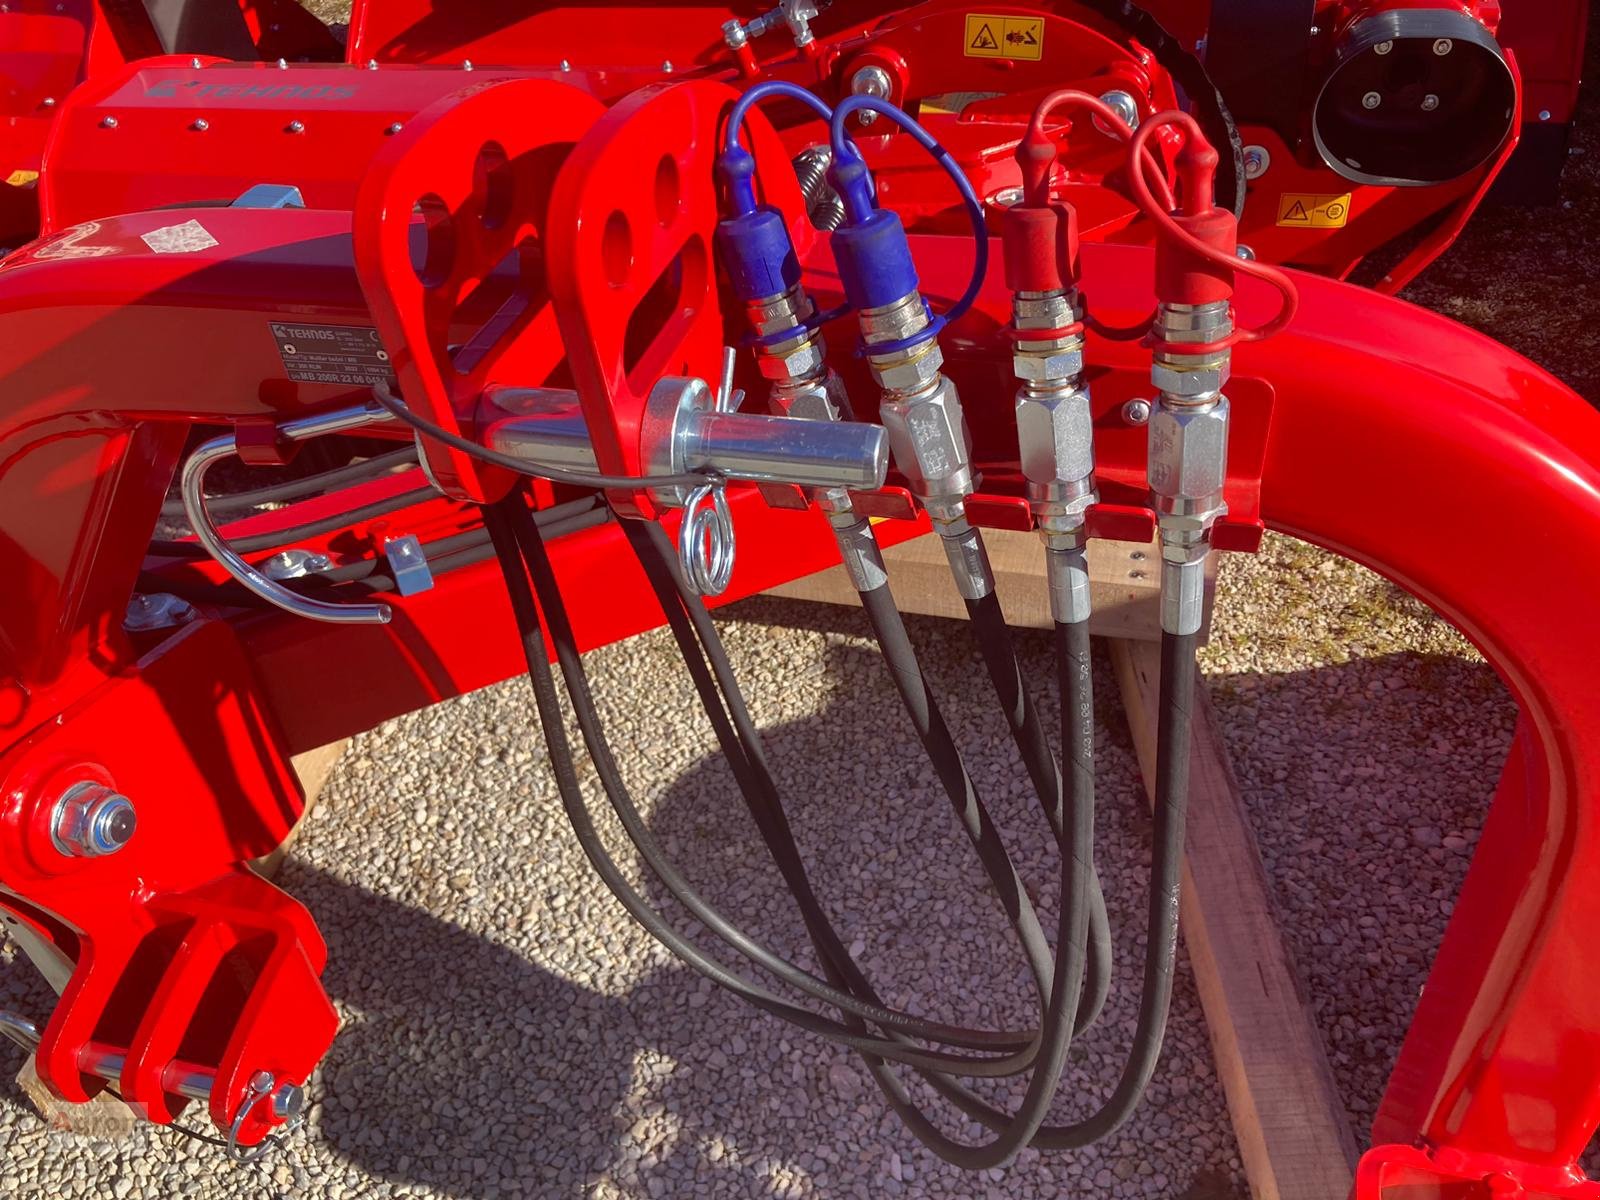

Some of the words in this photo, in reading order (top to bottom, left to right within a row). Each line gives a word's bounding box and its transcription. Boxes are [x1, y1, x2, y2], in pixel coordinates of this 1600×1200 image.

[196, 83, 360, 99] TEHNOS
[286, 328, 336, 340] TEHNOS
[300, 372, 315, 380] MB
